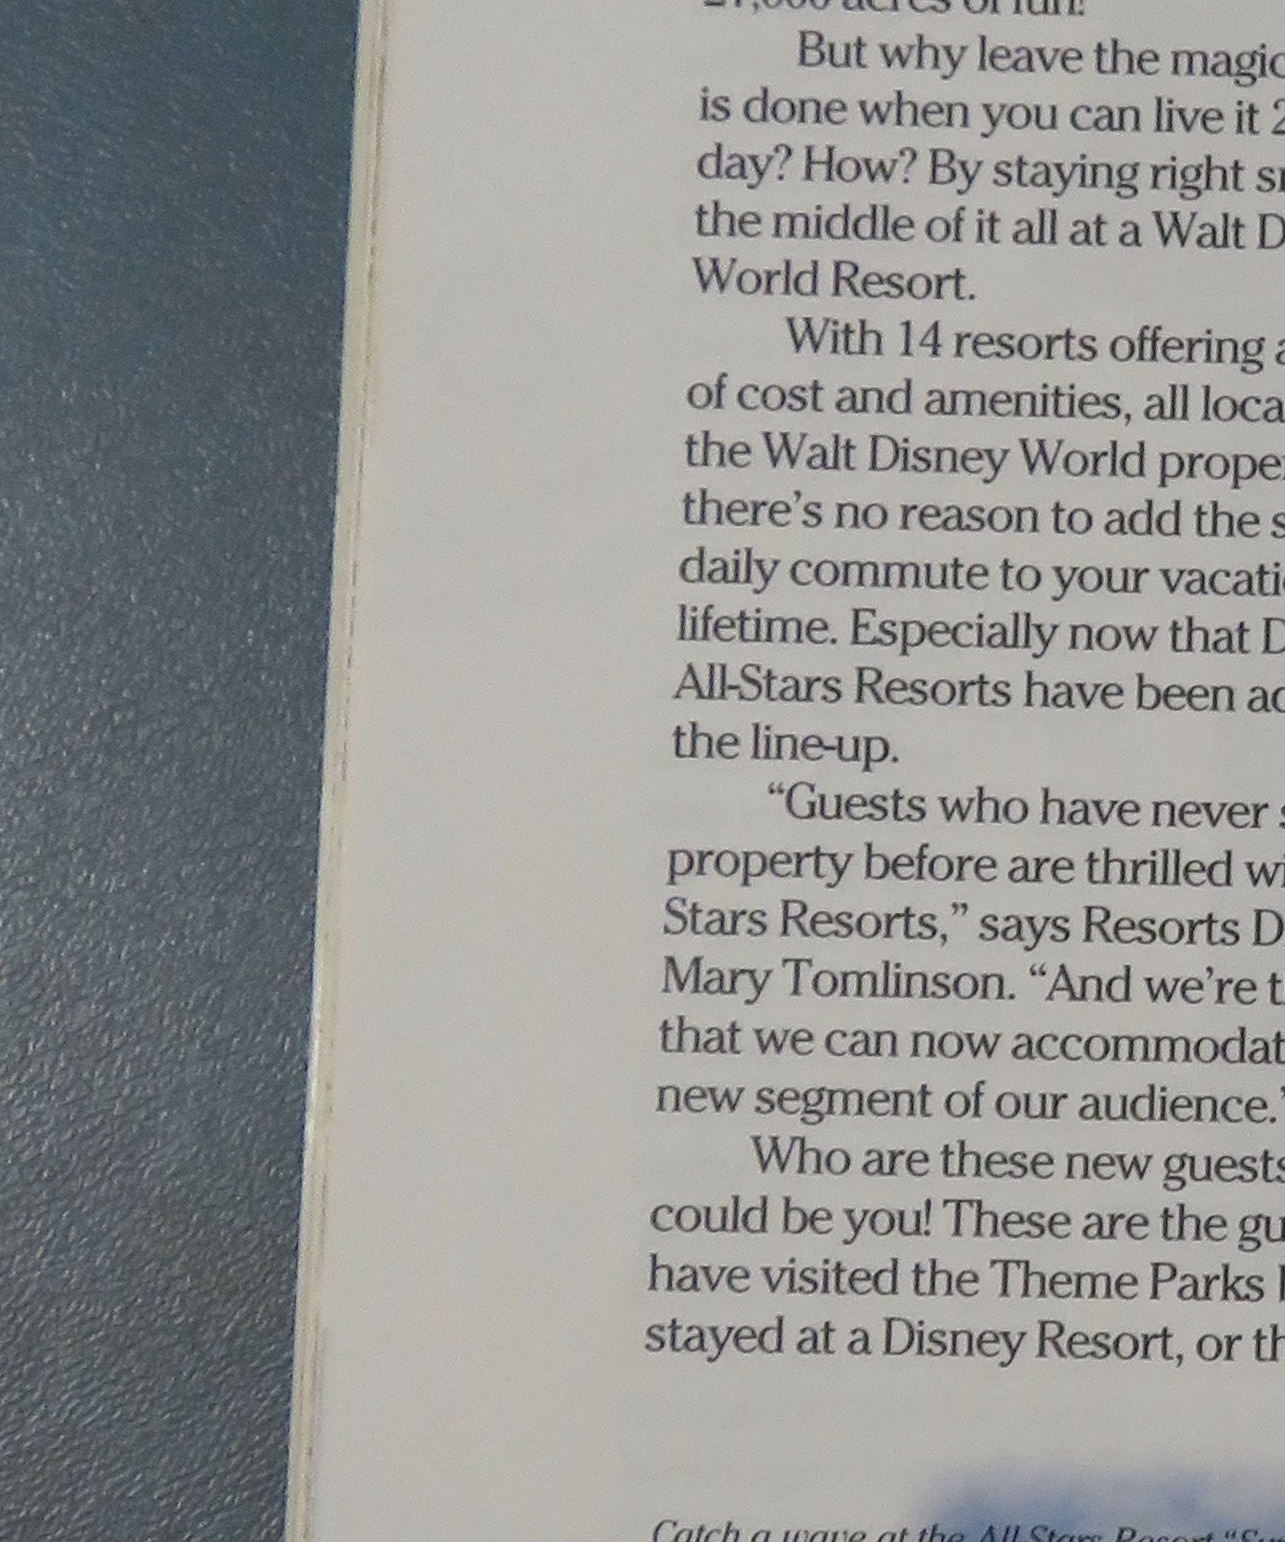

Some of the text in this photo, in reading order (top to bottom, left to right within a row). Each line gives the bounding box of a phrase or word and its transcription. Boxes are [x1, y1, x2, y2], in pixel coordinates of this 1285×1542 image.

[785, 316, 883, 356] With
[900, 320, 942, 357] 14
[953, 328, 1098, 362] resorts
[1109, 325, 1266, 375] offering
[672, 662, 842, 704] All-Stars
[855, 666, 1012, 707] Resorts
[1024, 670, 1124, 710] have
[1136, 672, 1236, 712] been
[659, 1015, 742, 1054] that
[753, 1028, 814, 1056] we
[824, 1029, 898, 1057] can
[910, 1031, 1002, 1059] now
[648, 1253, 750, 1293] have
[760, 1257, 899, 1295] visited
[911, 1258, 980, 1297] the
[990, 1259, 1138, 1300] Theme
[1150, 1262, 1265, 1303] Parks
